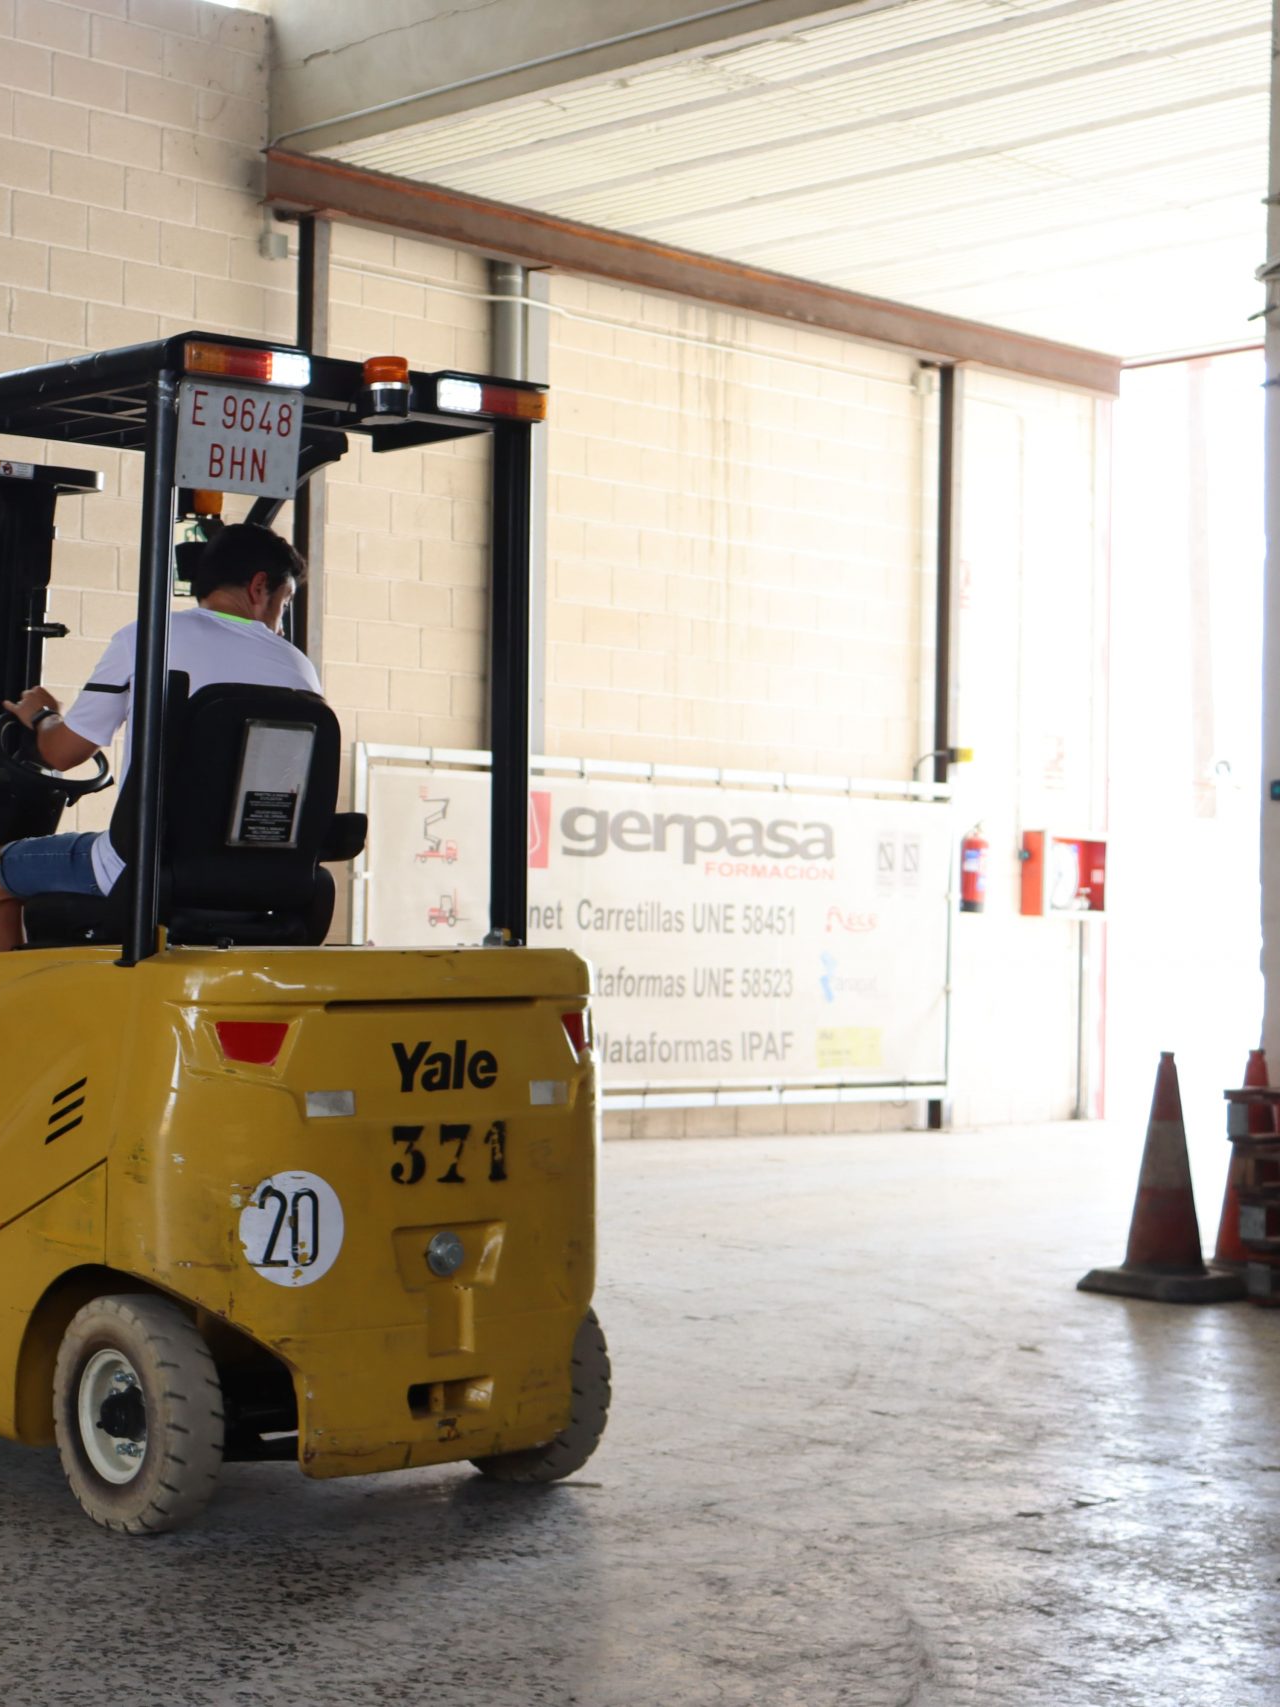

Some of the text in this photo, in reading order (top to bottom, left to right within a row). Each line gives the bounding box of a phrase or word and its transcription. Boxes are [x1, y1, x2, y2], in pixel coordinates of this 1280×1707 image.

[192, 390, 292, 437] E 9648
[208, 443, 267, 483] BHN
[560, 806, 835, 864] gerpasa
[528, 898, 795, 935] net Carretillas UNE 58451
[596, 965, 793, 998] taformas UNE 58523
[392, 1040, 498, 1092] Yale
[597, 1031, 795, 1064] lataformas IPAF
[390, 1120, 508, 1185] 371
[258, 1185, 319, 1267] 20
